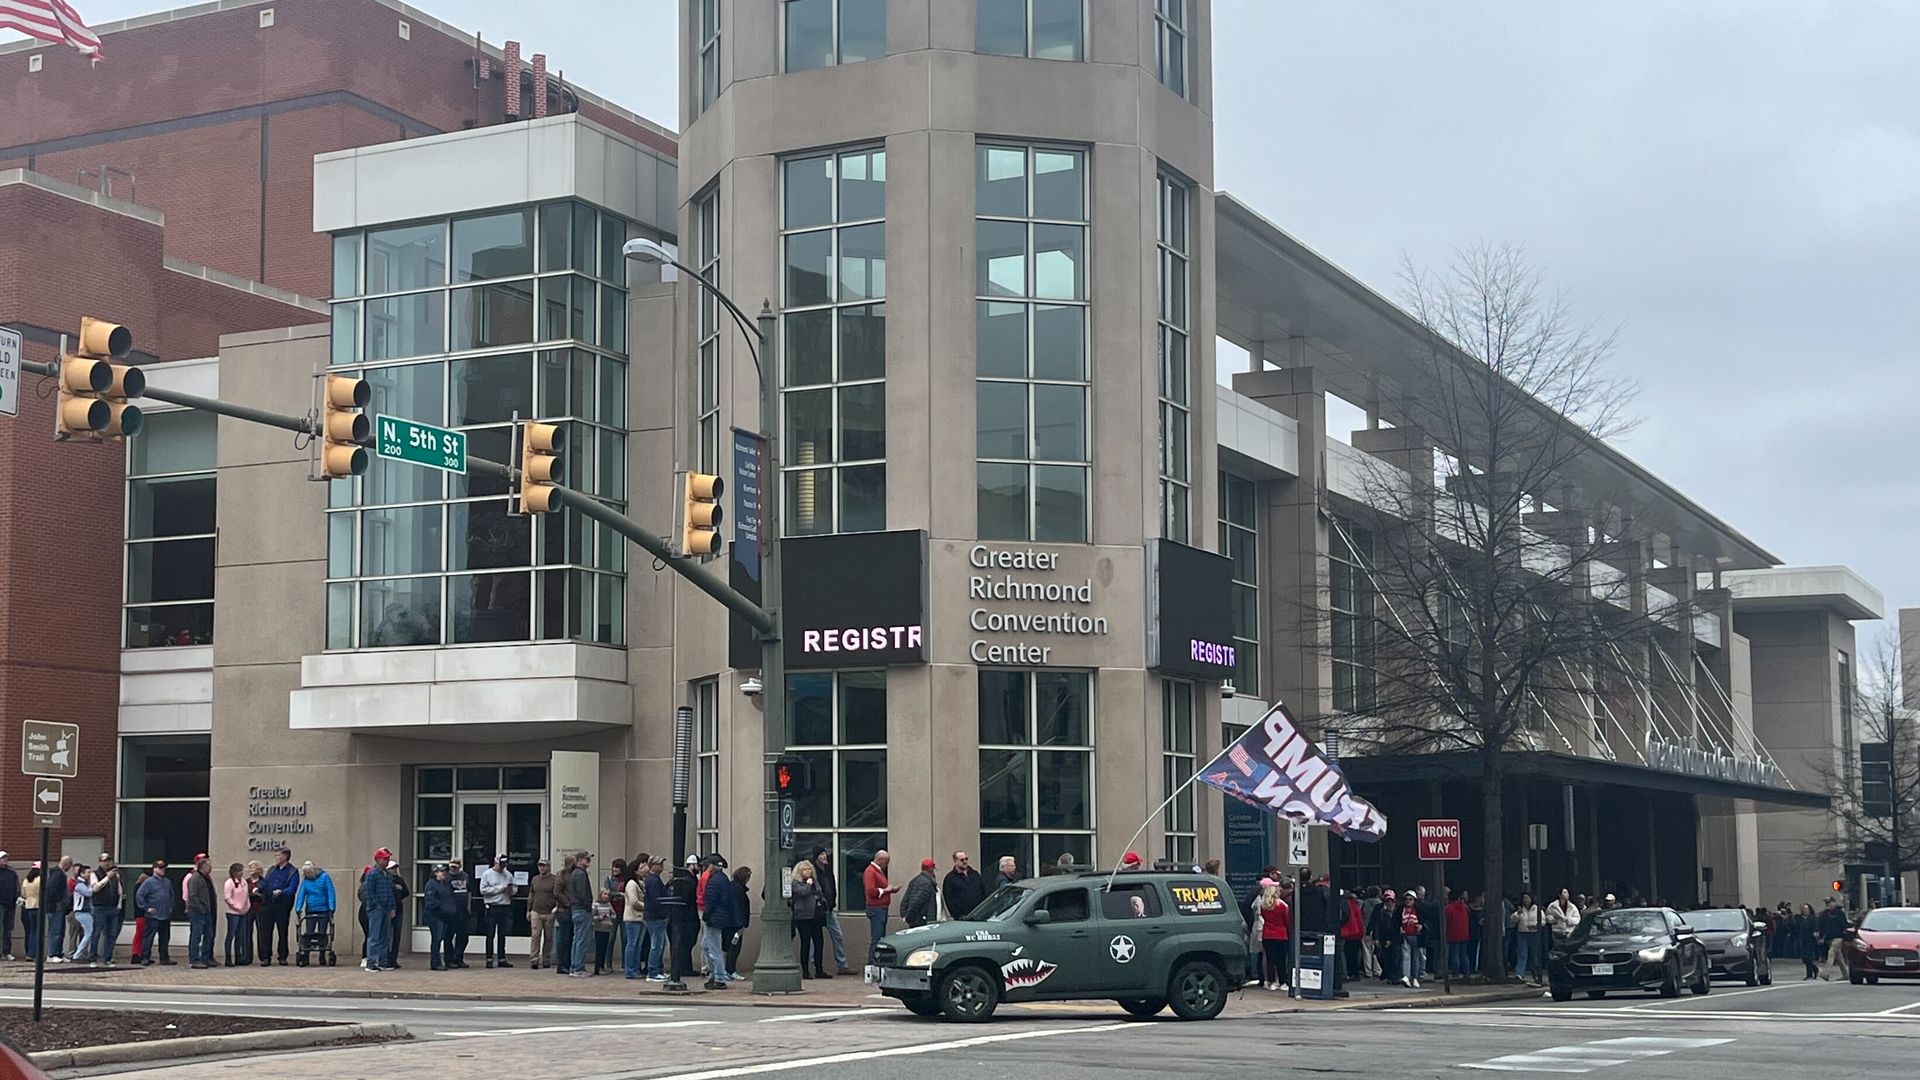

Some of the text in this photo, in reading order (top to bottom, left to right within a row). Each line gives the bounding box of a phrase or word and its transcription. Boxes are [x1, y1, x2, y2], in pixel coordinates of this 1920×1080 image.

[0, 338, 17, 349] URN
[383, 421, 459, 456] N. 5th St
[384, 444, 402, 456] 200
[443, 456, 459, 468] 300
[969, 544, 1059, 570] Greater
[969, 574, 1092, 602] Richmond
[970, 608, 1108, 634] Convention
[804, 625, 921, 652] REGISTR
[970, 640, 1051, 663] Center
[1191, 639, 1235, 667] REGISTR
[28, 732, 47, 741] John
[27, 742, 50, 752] Smith
[27, 752, 45, 761] Trail
[248, 786, 292, 799] Greater
[249, 801, 307, 816] Richmond
[248, 820, 314, 834] Convention
[1420, 825, 1457, 838] WRONG
[1292, 829, 1306, 842] WAY
[247, 837, 286, 851] Center
[1428, 842, 1450, 854] WAY
[1172, 887, 1219, 902] TRUMP
